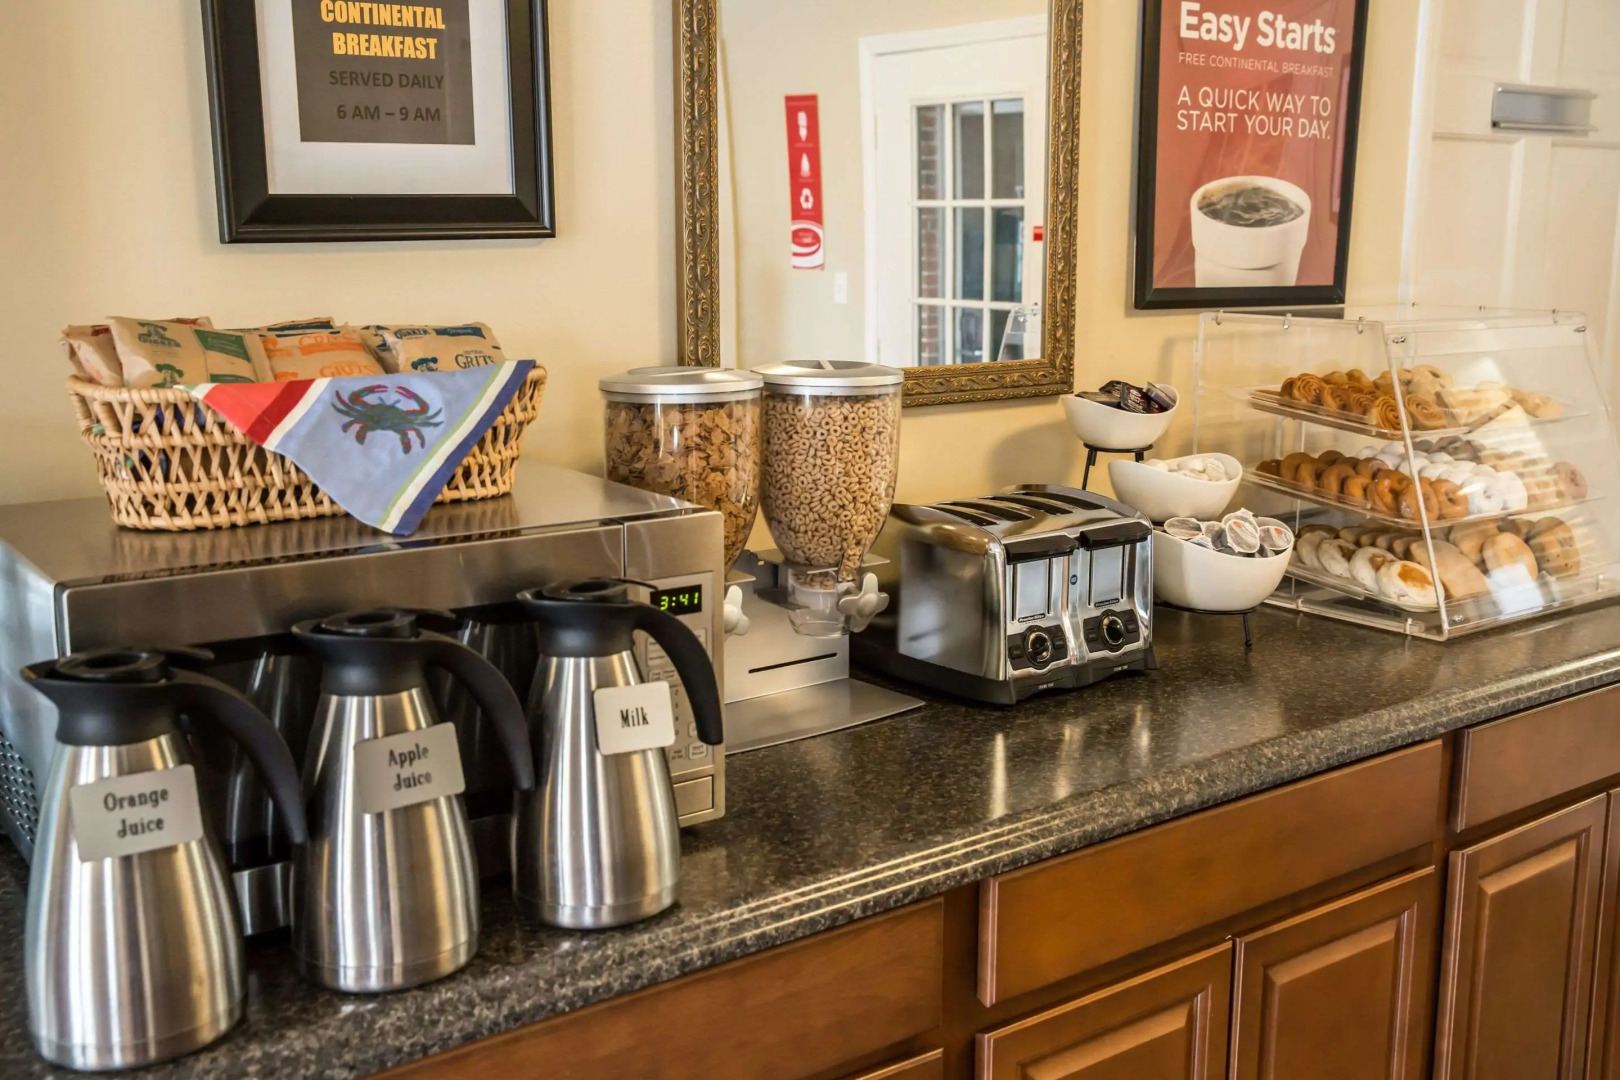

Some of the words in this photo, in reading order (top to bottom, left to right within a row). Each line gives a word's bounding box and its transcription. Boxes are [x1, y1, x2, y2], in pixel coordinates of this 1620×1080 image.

[320, 0, 446, 30] CONTINENTAL
[1179, 1, 1251, 51] Easy
[1256, 10, 1337, 54] Starts
[332, 32, 438, 60] BREAKFAST
[1178, 52, 1206, 67] FREE
[1209, 55, 1279, 74] CONTINENTAL
[1282, 62, 1334, 78] BREAKFAST
[328, 70, 394, 88] SERVED
[398, 73, 444, 90] DAILY
[336, 104, 347, 120] 6
[351, 105, 381, 121] AM
[399, 106, 409, 122] 9
[413, 107, 441, 123] AM
[1177, 85, 1192, 107] A
[1198, 86, 1260, 112] QUICK
[1265, 92, 1306, 115] WAY
[1310, 95, 1332, 118] TO
[1177, 110, 1239, 134] START
[1244, 114, 1293, 137] YOUR
[1297, 117, 1332, 140] DAY.
[659, 592, 699, 611] 3:41
[620, 707, 650, 729] Milk
[388, 743, 430, 769] Apple
[394, 769, 433, 792] Juice
[103, 785, 169, 813] Orange
[117, 818, 165, 839] Juice
